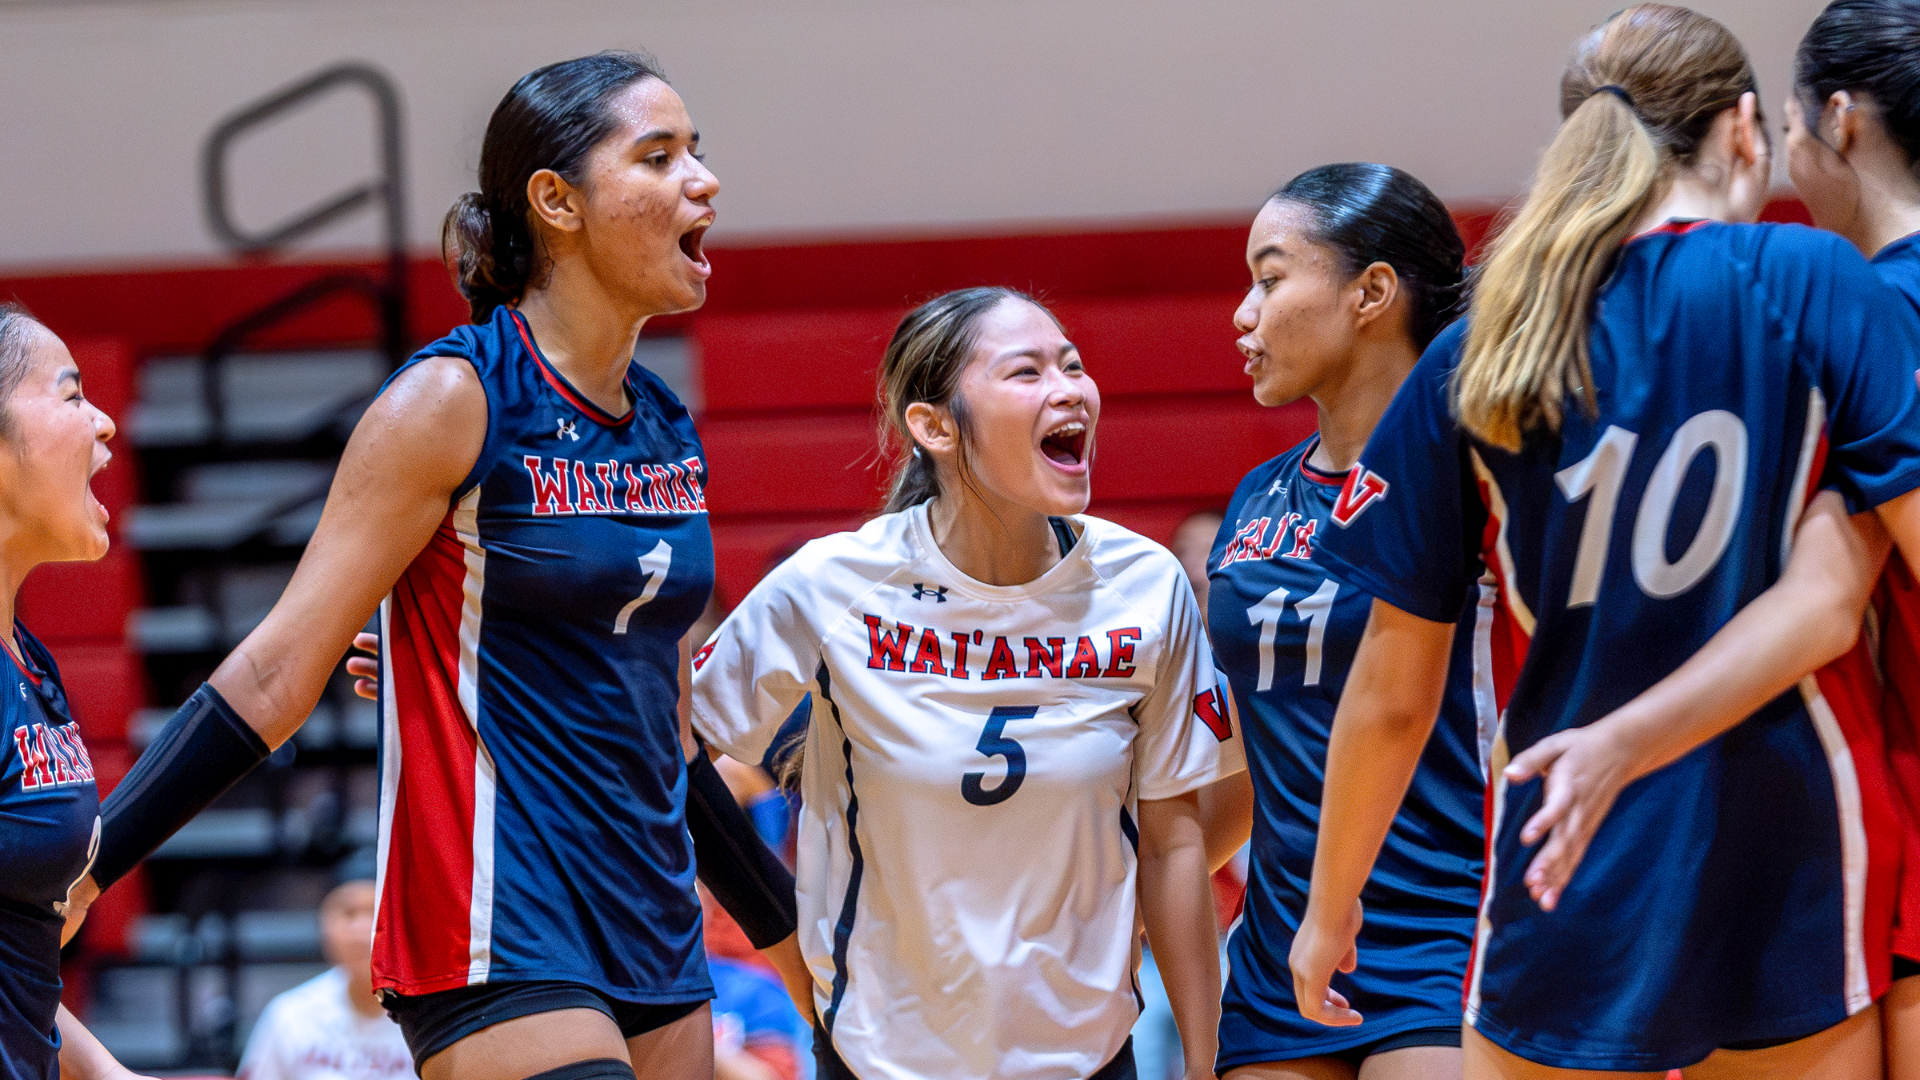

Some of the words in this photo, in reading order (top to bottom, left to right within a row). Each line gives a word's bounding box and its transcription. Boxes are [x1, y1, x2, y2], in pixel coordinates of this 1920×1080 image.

[1331, 462, 1390, 529] V
[1553, 409, 1749, 609] 10
[1218, 511, 1318, 570] WAI'A
[613, 538, 673, 634] 1
[863, 613, 1142, 680] WAI'ANAE
[1246, 578, 1339, 691] 11
[1193, 684, 1233, 742] V
[960, 705, 1040, 806] 5
